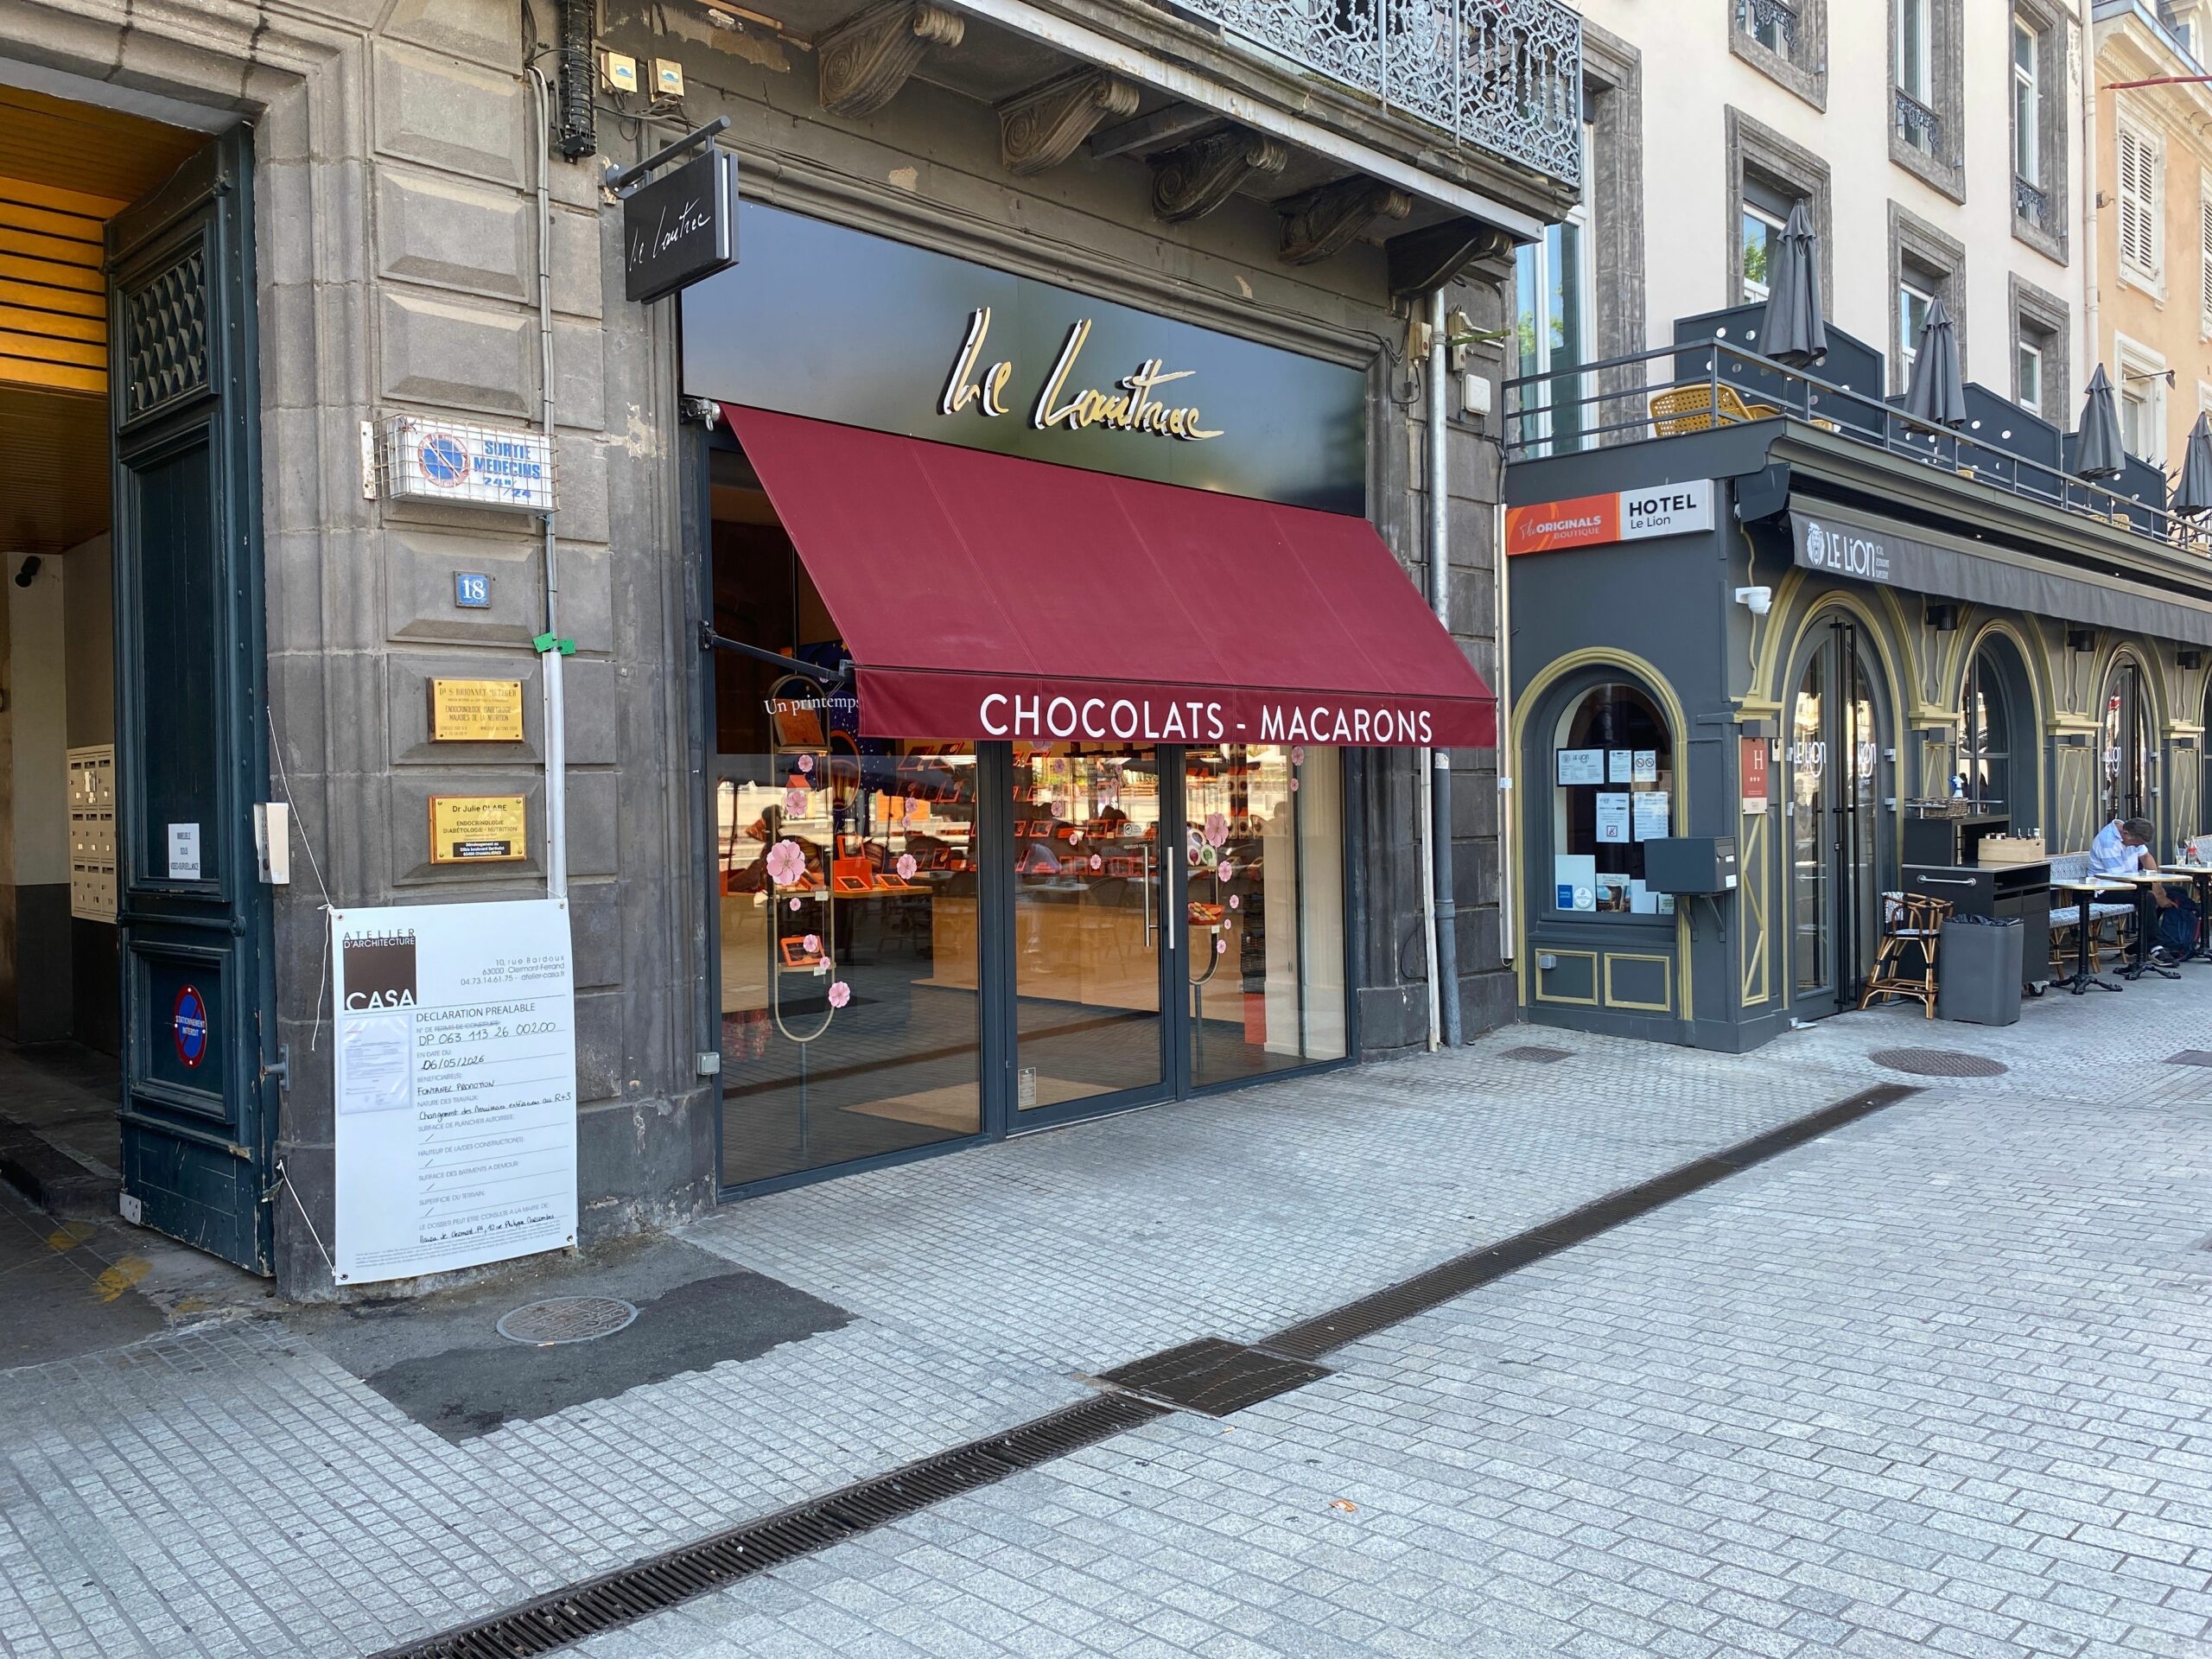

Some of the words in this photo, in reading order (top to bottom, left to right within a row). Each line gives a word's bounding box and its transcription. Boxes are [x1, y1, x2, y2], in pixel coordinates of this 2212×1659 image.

[629, 227, 644, 272] Le
[652, 197, 711, 258] Lautrec
[942, 307, 1012, 416] Le
[1034, 318, 1225, 441] Lautrec
[485, 439, 531, 460] SORTIE
[474, 456, 541, 480] MEDECINS
[1630, 493, 1697, 517] HOTEL
[1536, 515, 1602, 534] ORIGINALS
[1630, 519, 1643, 530] Le
[1647, 516, 1671, 527] Lion
[1554, 526, 1600, 540] BOUTIQUE
[1826, 531, 1841, 569] LE
[463, 579, 486, 600] 18
[764, 698, 787, 715] Un
[980, 693, 1224, 740] CHOCOLATS
[1260, 704, 1433, 743] MACARONS
[1753, 750, 1764, 770] H
[344, 928, 415, 941] ATELIER
[344, 938, 416, 949] D'ARCHITECTURE
[526, 955, 565, 963] Bardoux
[482, 967, 505, 976] 63000
[508, 963, 565, 973] Clermont-Ferrand
[461, 975, 513, 986] 04.73.14.61.75
[521, 970, 565, 981] atelier-casa.fr
[346, 988, 416, 1010] CASA
[416, 1007, 483, 1022] DECLARATION
[486, 1002, 536, 1015] PREALABLE
[175, 1014, 206, 1028] STATIONNEMENT
[182, 1026, 199, 1036] INTERDIT
[418, 1033, 435, 1046] DP
[439, 1033, 461, 1045] 063
[468, 1028, 488, 1040] 113
[494, 1027, 509, 1038] 26
[555, 1091, 571, 1102] R+3
[417, 1123, 444, 1133] SURFACE
[454, 1118, 485, 1127] PLANCHER
[417, 1147, 444, 1156] HAUTEUR
[454, 1143, 474, 1152] LA/DES
[418, 1172, 445, 1181] SURFACE
[419, 1195, 451, 1205] SUPERFICIE
[427, 1219, 451, 1230] DOSSIER
